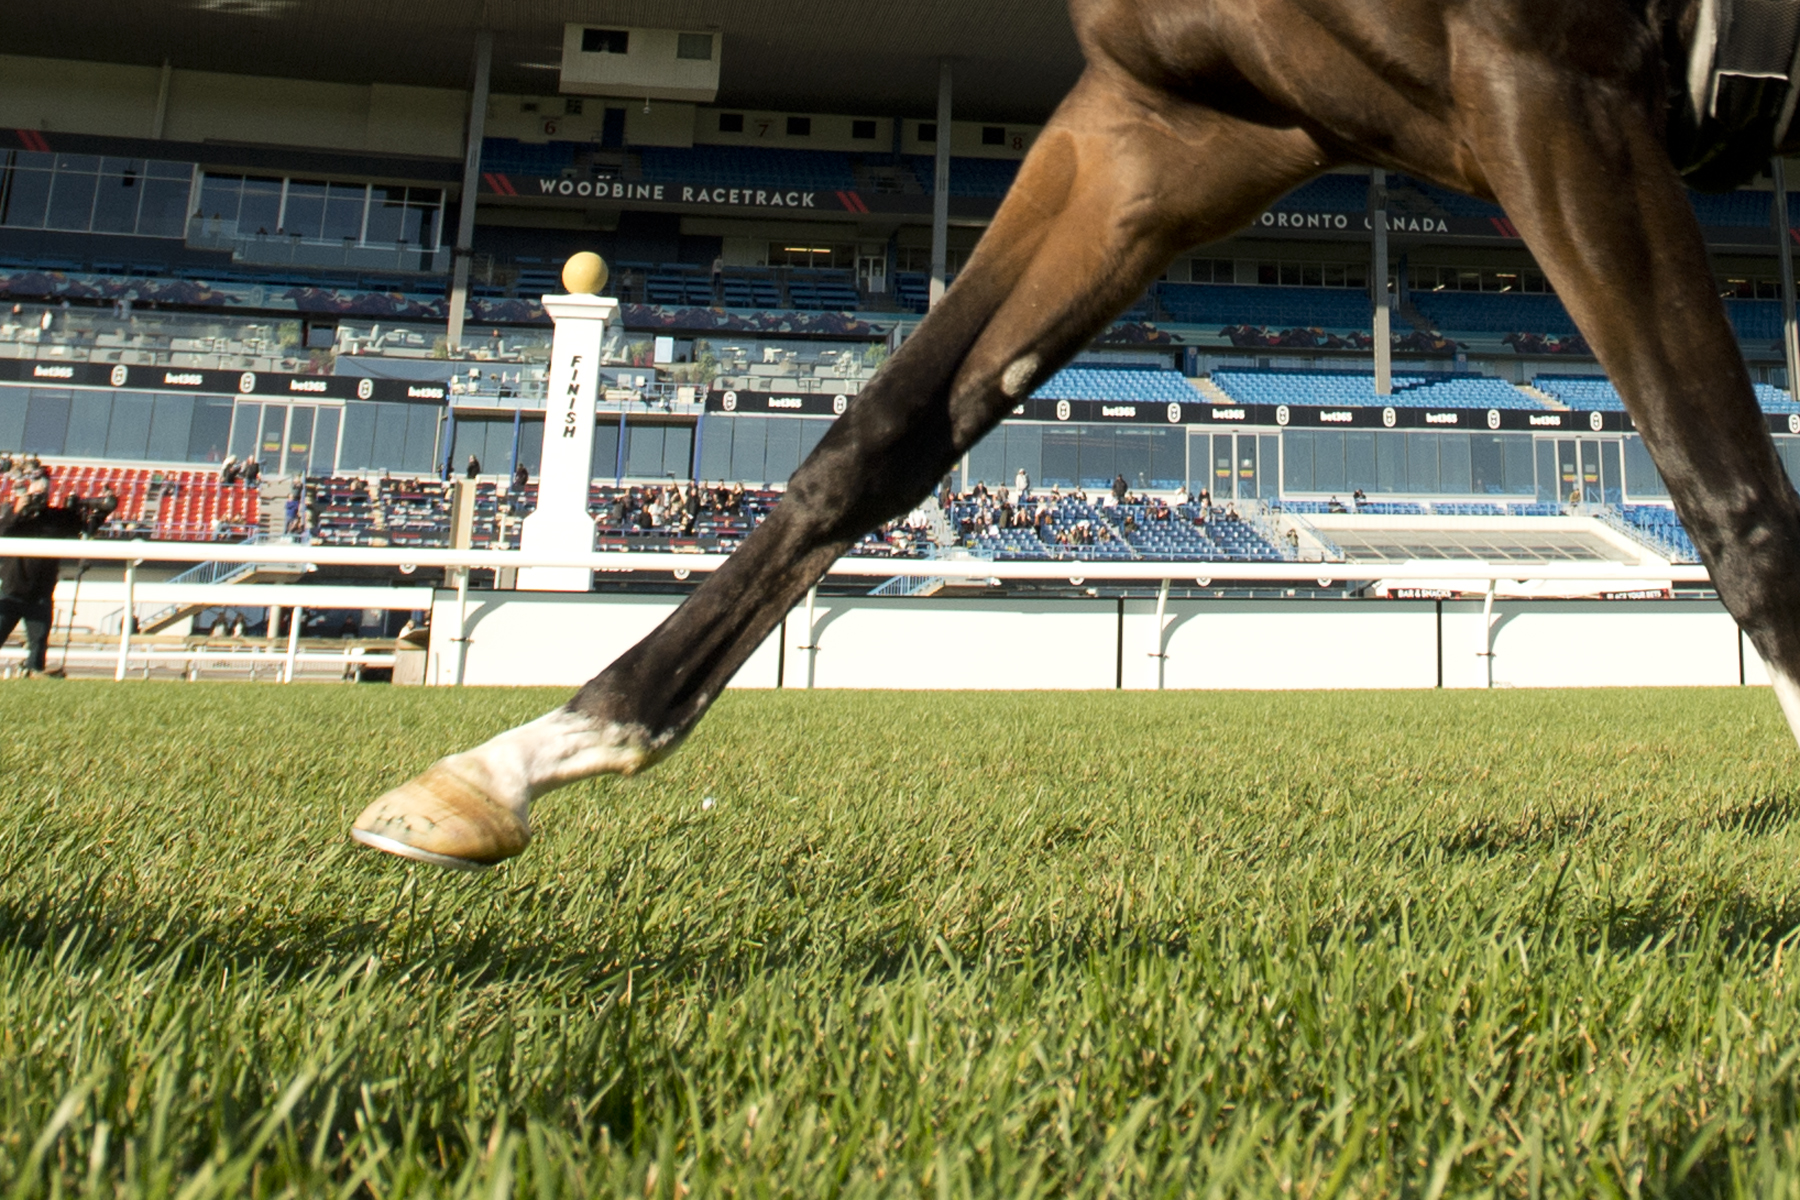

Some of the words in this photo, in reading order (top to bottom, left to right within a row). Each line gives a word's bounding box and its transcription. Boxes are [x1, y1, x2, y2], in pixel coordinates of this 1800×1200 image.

[759, 123, 769, 138] 7
[1013, 136, 1023, 150] 8
[540, 179, 664, 200] WOODBINE
[683, 187, 815, 208] RACETRACK
[1253, 211, 1348, 229] ORONTO
[562, 355, 583, 438] FINISH
